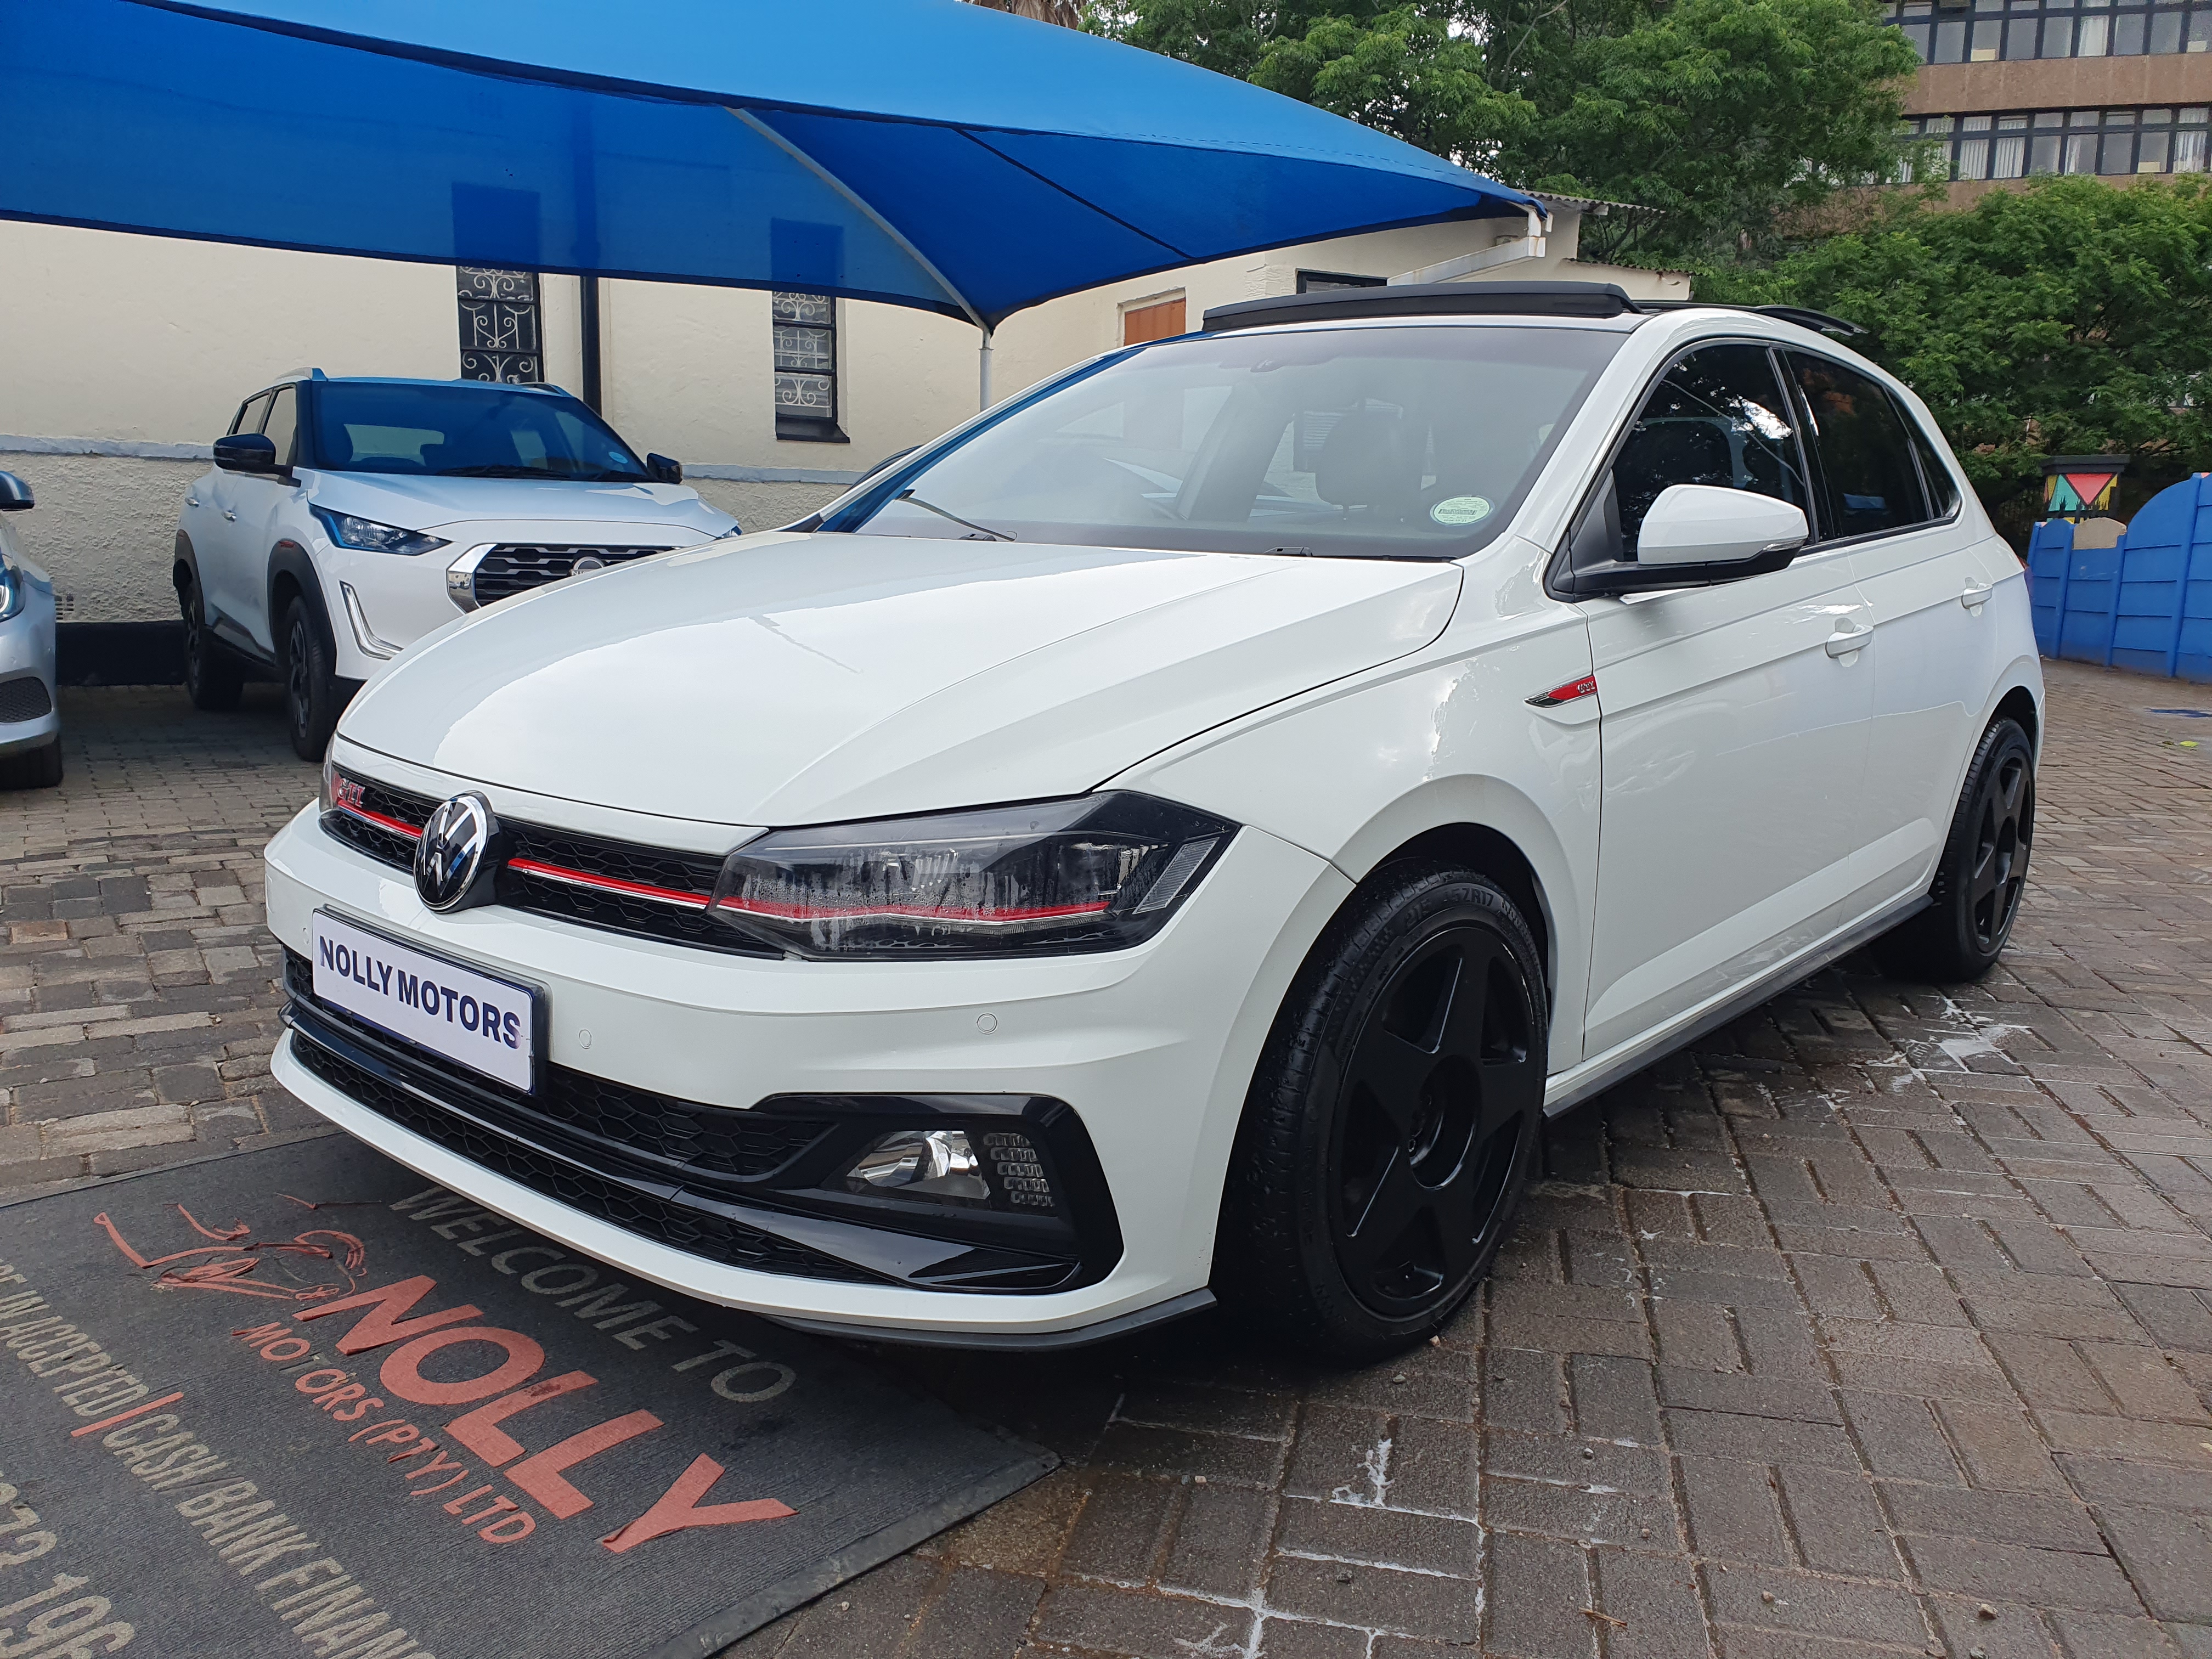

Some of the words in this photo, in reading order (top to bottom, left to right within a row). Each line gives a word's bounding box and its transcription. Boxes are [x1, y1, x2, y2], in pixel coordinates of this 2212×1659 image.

[337, 778, 365, 808] GTI
[320, 935, 392, 996] NOLLY
[398, 969, 521, 1049] MOTORS
[388, 1184, 700, 1350] WELCOME
[672, 1339, 798, 1403] TO
[0, 1316, 149, 1417] ACCEPTED
[255, 1556, 436, 1659] FINAN
[232, 1322, 384, 1421] MOTORS
[348, 1419, 469, 1496] (PTY)
[443, 1485, 537, 1544] LTD
[292, 1274, 800, 1553] NOLLY
